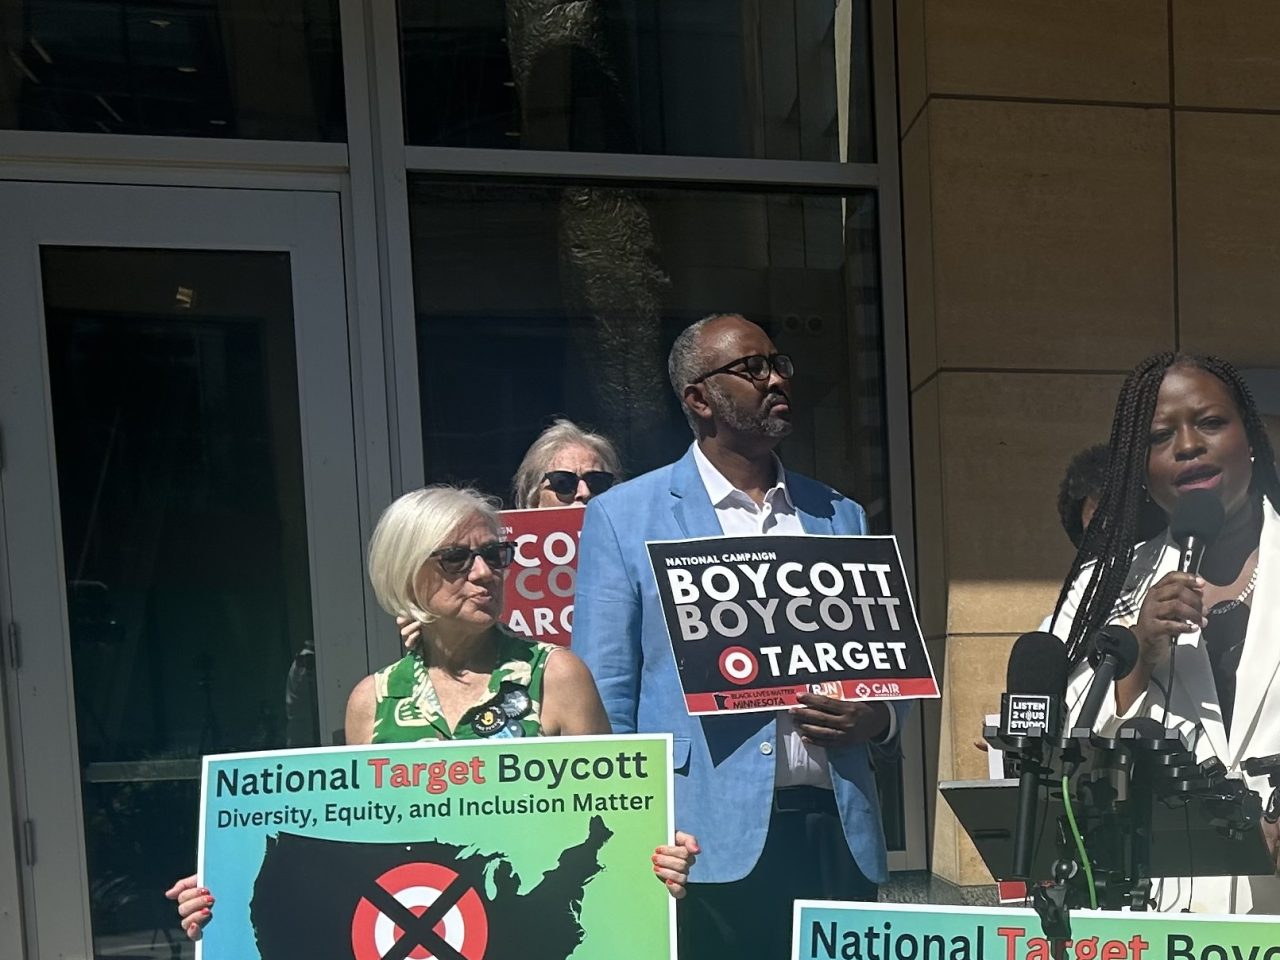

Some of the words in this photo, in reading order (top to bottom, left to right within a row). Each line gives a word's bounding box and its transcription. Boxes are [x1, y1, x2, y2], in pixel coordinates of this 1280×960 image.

[665, 555, 720, 567] NATIONAL
[722, 552, 777, 563] CAMPAIGN
[666, 562, 892, 605] BOYCOTT
[675, 597, 901, 641] BOYCOTT
[760, 642, 907, 677] TARGET
[813, 684, 837, 695] RJN
[872, 684, 900, 694] CAIR
[733, 698, 785, 709] MINNESOTA
[1013, 702, 1045, 710] LISTEN
[216, 760, 360, 797] National
[367, 756, 486, 794] Target
[498, 750, 648, 789] Boycott
[217, 803, 318, 829] Diversity,
[324, 800, 404, 824] Equity,
[410, 798, 452, 819] and
[459, 794, 565, 816] Inclusion
[572, 792, 654, 813] Matter
